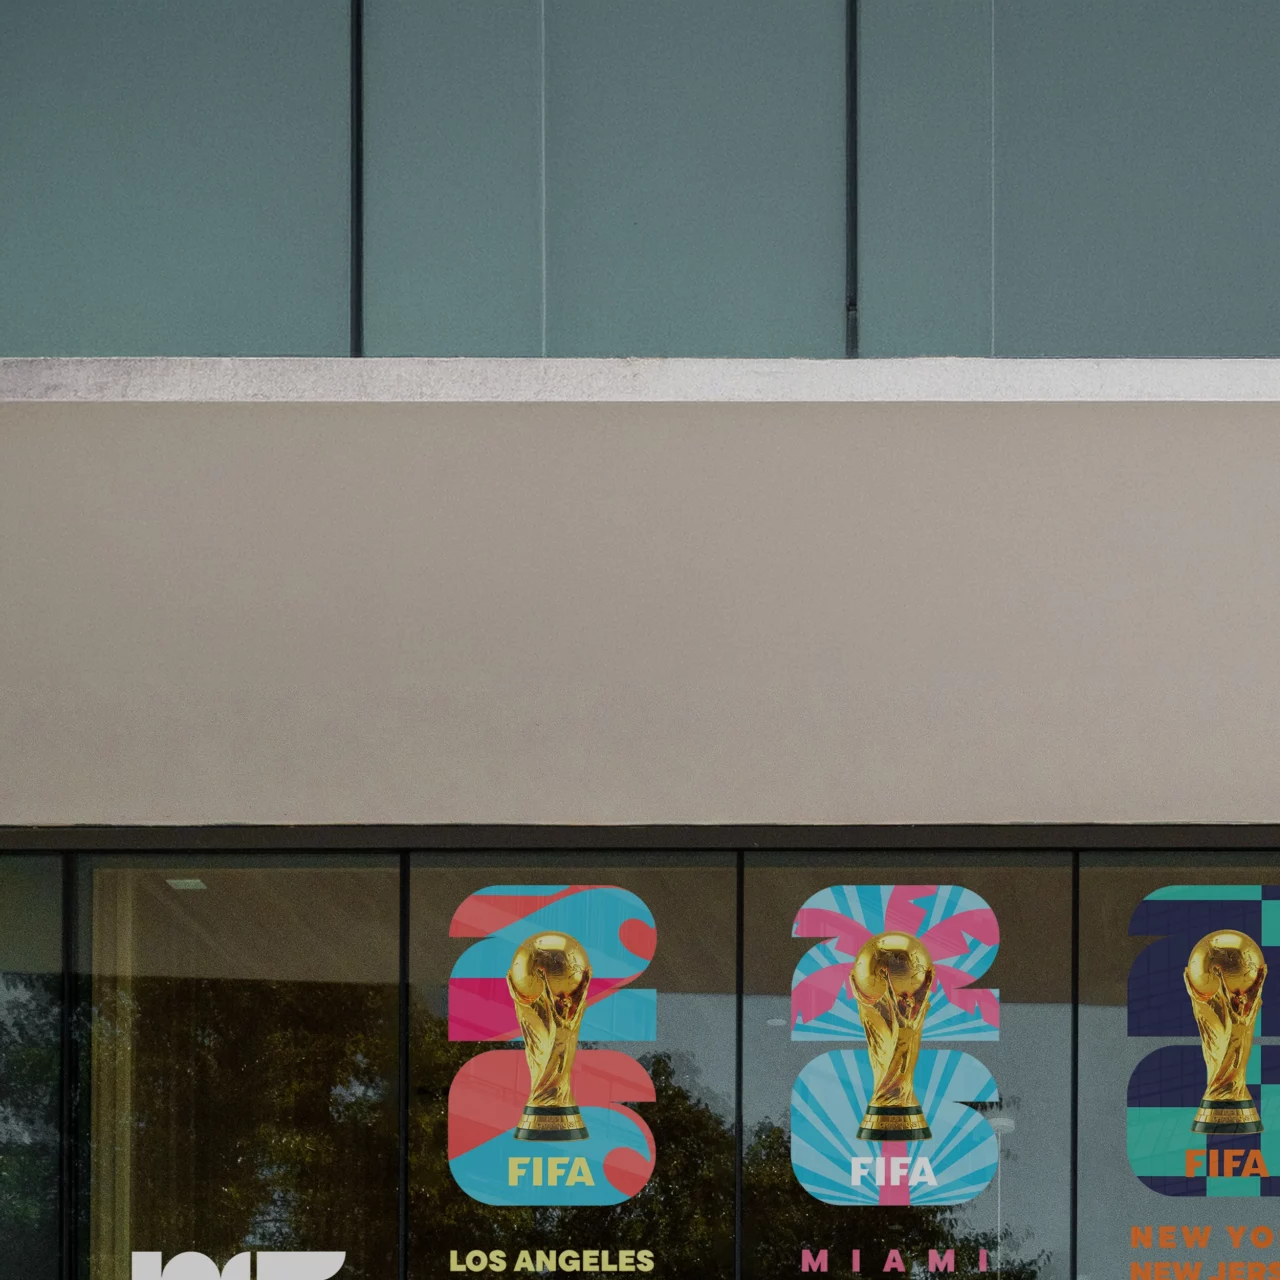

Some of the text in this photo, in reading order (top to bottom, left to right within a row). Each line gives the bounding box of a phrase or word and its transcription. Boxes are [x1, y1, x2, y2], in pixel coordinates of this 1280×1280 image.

[507, 1157, 595, 1187] FIFA
[851, 1157, 938, 1186] FIFA
[1185, 1150, 1270, 1178] FIFA
[1130, 1226, 1211, 1249] NEW
[450, 1249, 655, 1273] LOS ANGELES
[801, 1249, 990, 1272] MIAMI
